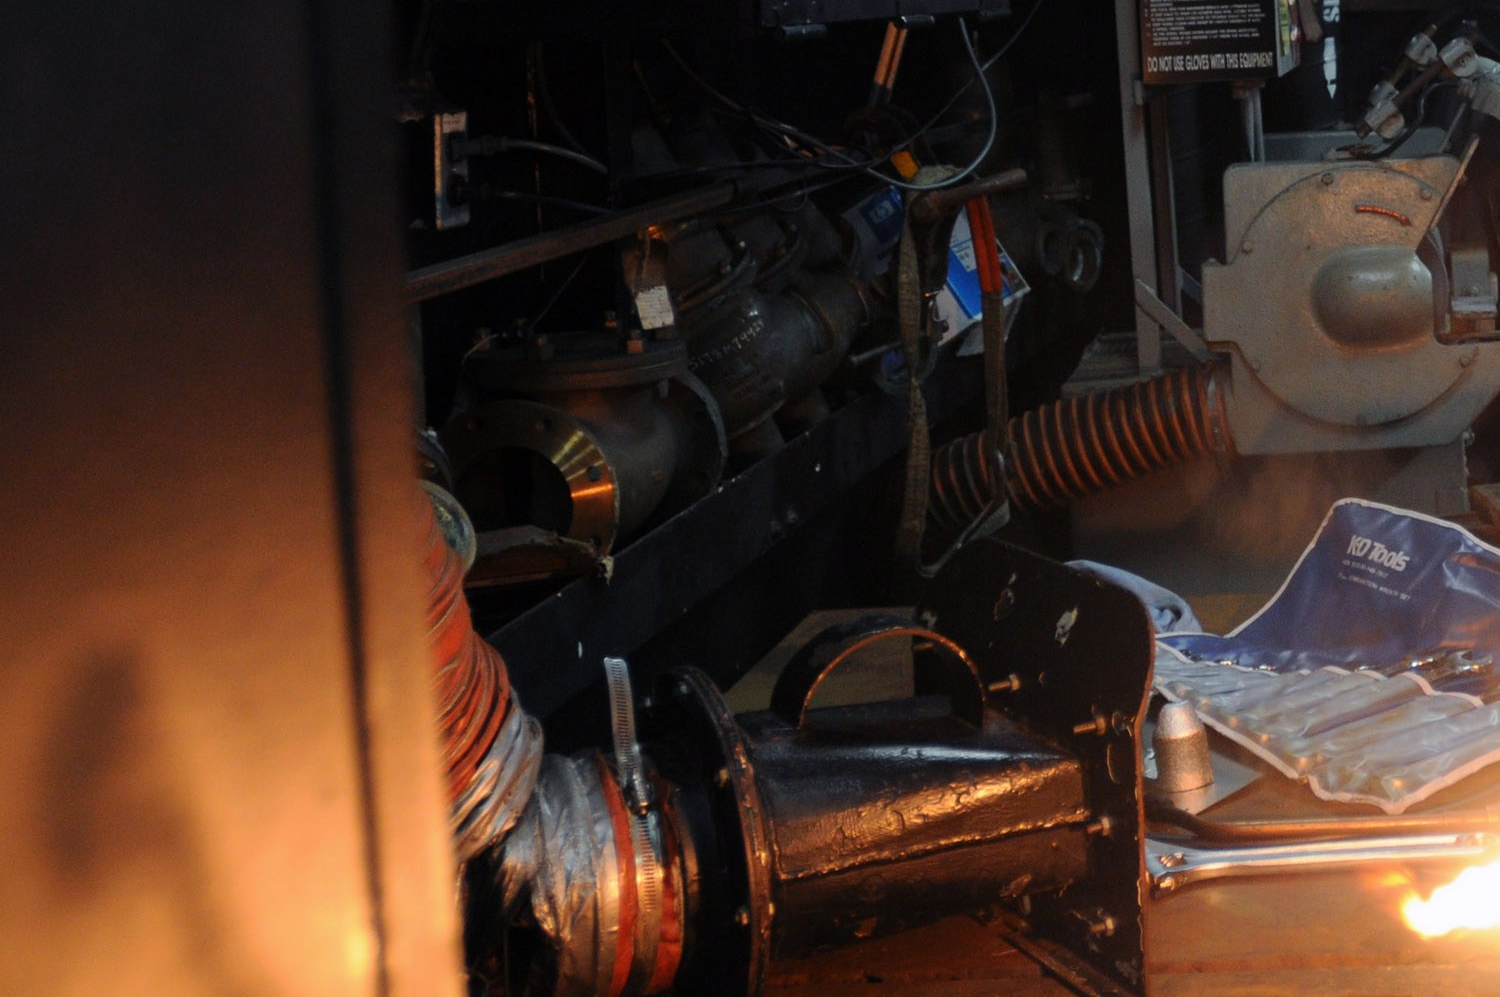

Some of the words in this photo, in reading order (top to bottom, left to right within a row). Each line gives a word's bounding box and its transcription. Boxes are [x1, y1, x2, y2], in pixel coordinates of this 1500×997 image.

[1147, 56, 1159, 73] DO
[1159, 55, 1173, 72] NOT
[1173, 54, 1185, 72] USE
[1185, 53, 1210, 71] GLOVES
[1210, 53, 1226, 70] WITH
[1225, 52, 1239, 69] THIS
[1239, 51, 1274, 69] EQUIPMENT
